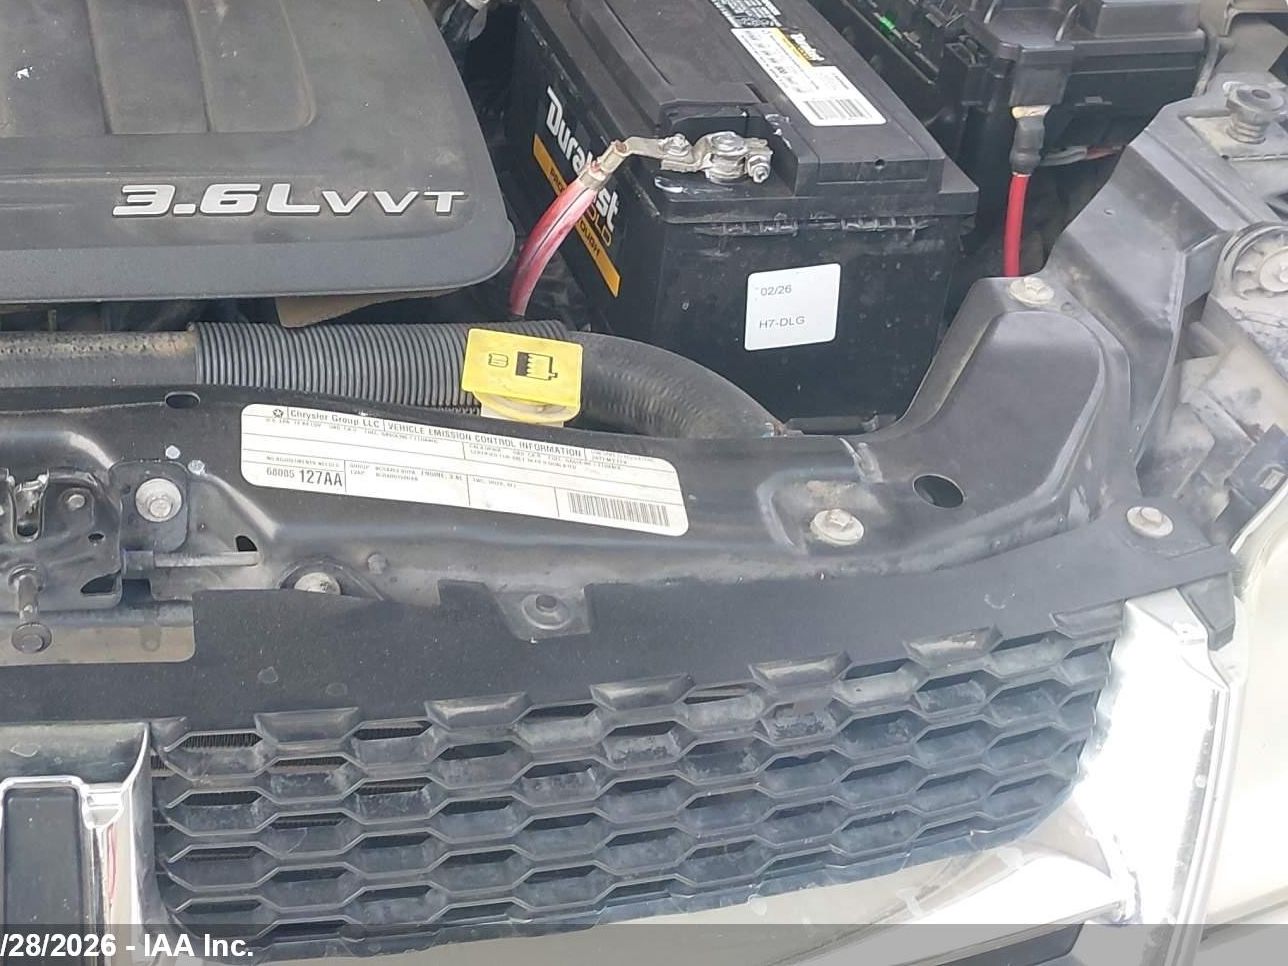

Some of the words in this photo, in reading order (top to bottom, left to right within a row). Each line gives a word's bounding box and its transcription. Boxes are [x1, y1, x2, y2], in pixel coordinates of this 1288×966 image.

[760, 284, 793, 296] 02/26
[759, 315, 806, 329] H7-DLG
[290, 409, 329, 422] Chrysler
[331, 414, 359, 426] Group
[362, 418, 380, 429] LLC
[388, 423, 426, 435] VEHICLE
[428, 428, 472, 441] EMISSION
[475, 435, 517, 448] CONTROL
[519, 441, 582, 457] INFORMATION
[299, 469, 343, 487] 127AA
